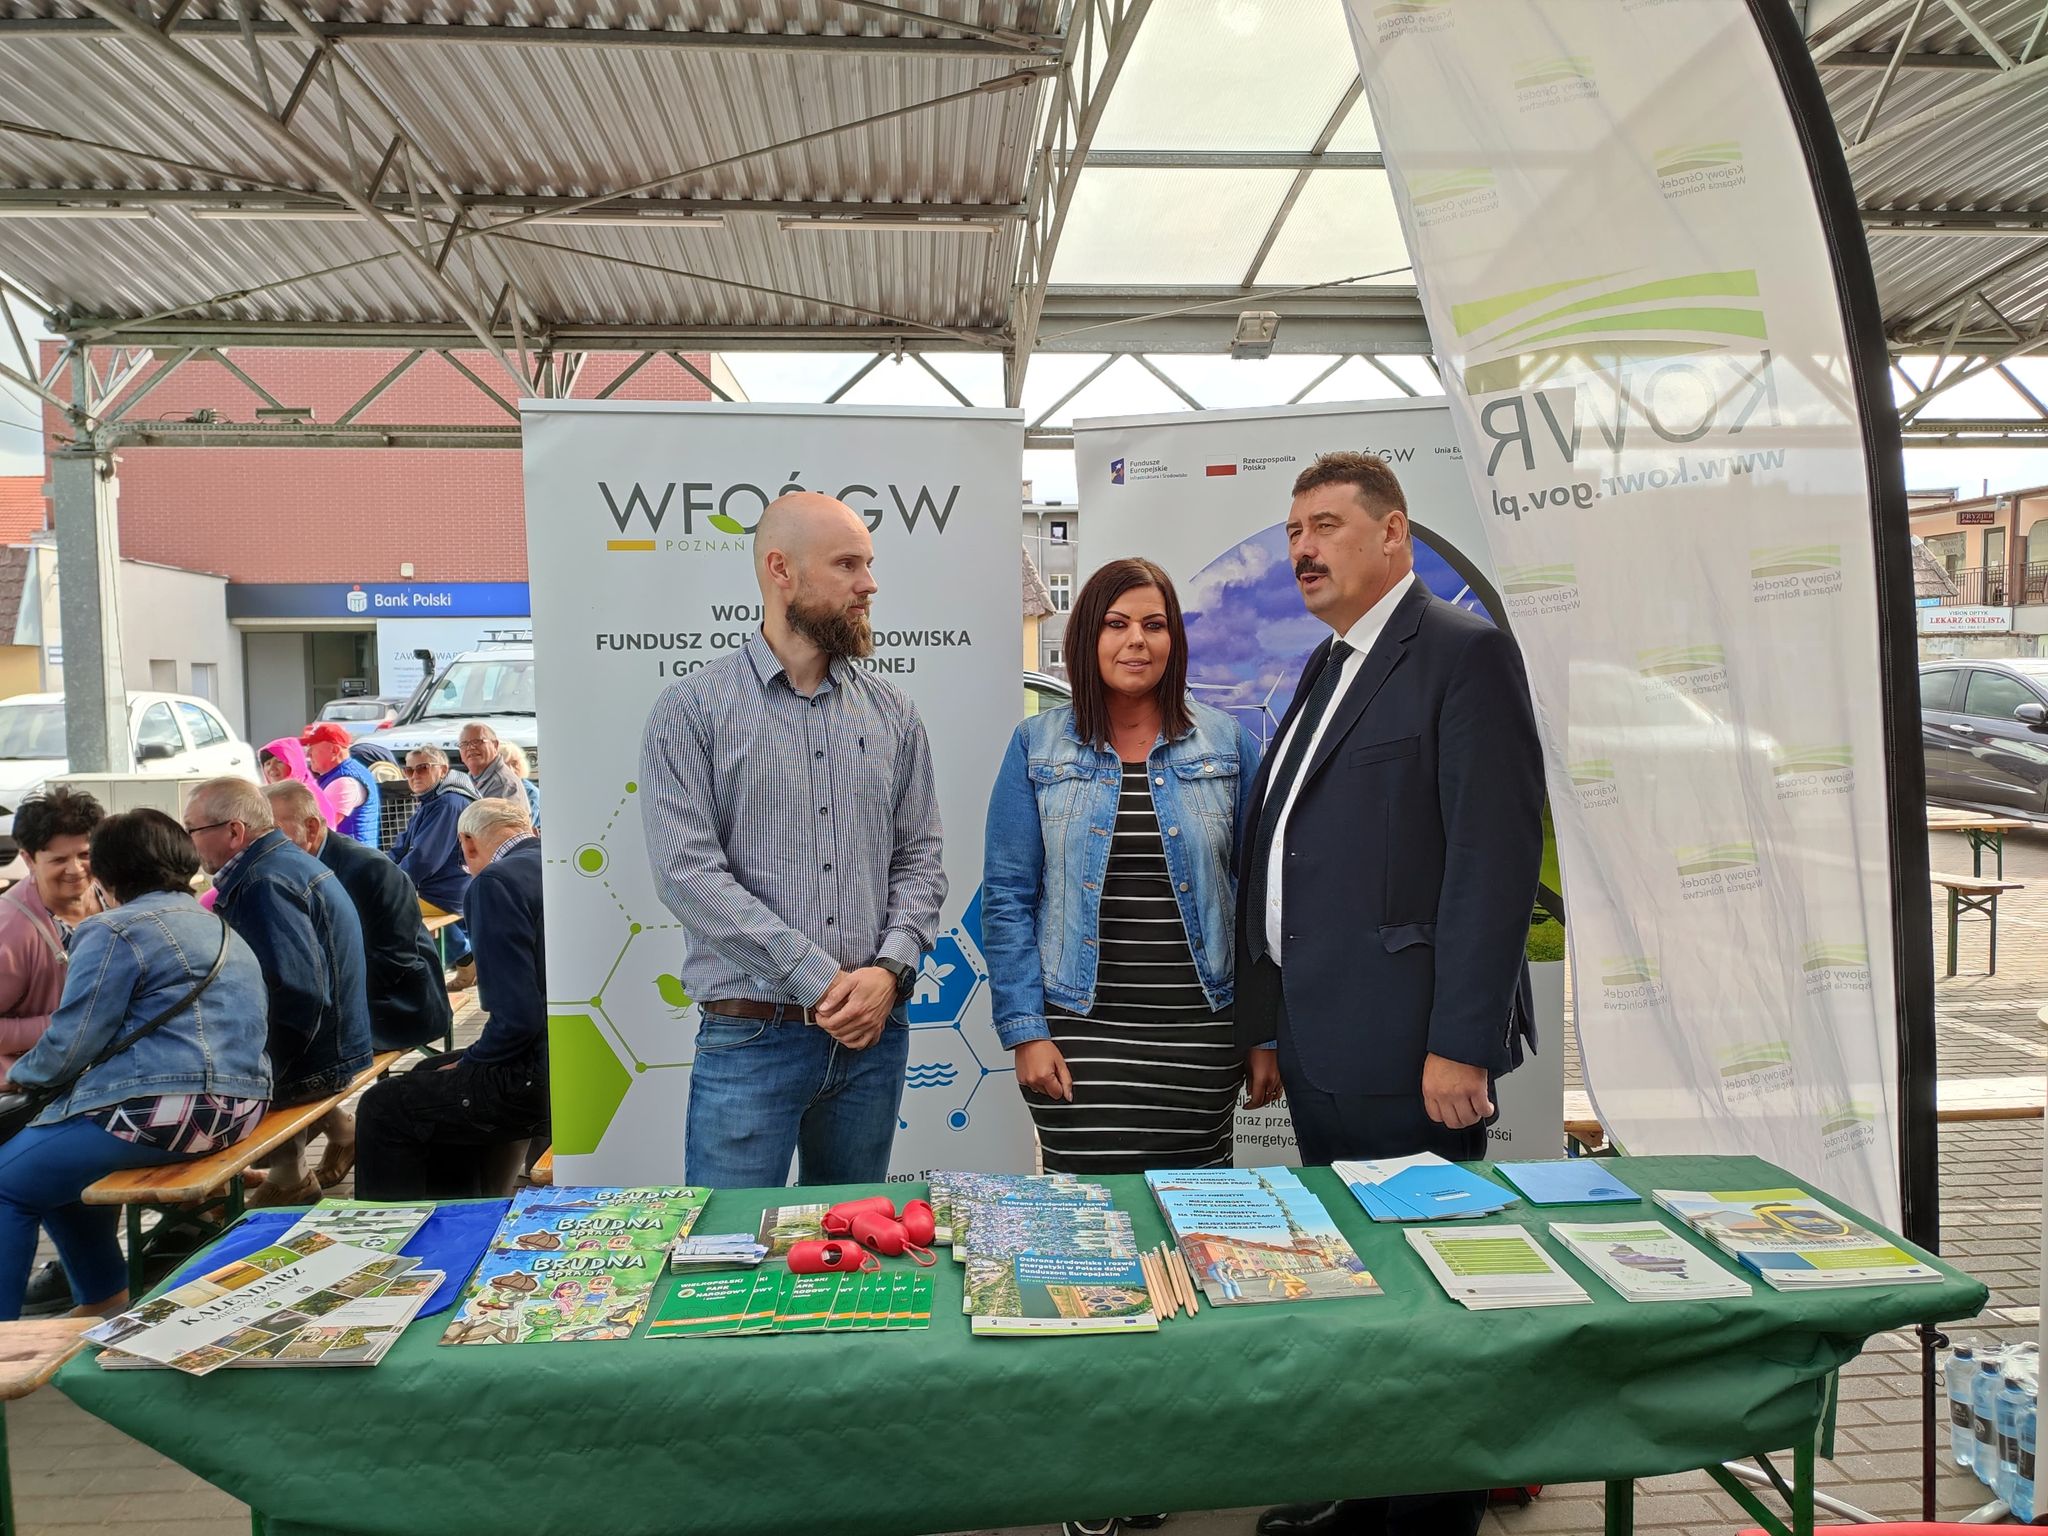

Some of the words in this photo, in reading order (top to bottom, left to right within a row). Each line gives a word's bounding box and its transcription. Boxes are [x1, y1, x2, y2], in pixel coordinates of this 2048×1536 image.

[1130, 459, 1160, 468] Fundusze
[1243, 455, 1296, 464] Rzeczpospolita
[1130, 465, 1168, 474] Europejskie
[1961, 512, 1993, 520] FRYZJER
[665, 537, 744, 552] POZNAŃ
[374, 593, 408, 607] Bank
[413, 592, 451, 607] Polski
[1965, 616, 2006, 624] OKULISTA
[596, 632, 702, 650] FUNDUSZ
[873, 630, 971, 647] DOWISKA
[659, 661, 664, 677] I
[1236, 1116, 1261, 1126] oraz
[1265, 1117, 1291, 1129] prze
[1487, 1127, 1512, 1141] ości
[595, 1188, 695, 1201] BRUDNA
[556, 1217, 662, 1231] BRUDNA
[1750, 1236, 1873, 1247] Termomodernizacja
[533, 1254, 646, 1272] BRUDNA
[1019, 1256, 1054, 1264] Ochrona
[1055, 1258, 1103, 1266] środowiska
[1020, 1262, 1066, 1271] energetyki
[680, 1278, 744, 1288] WIELKOPOLSKI
[706, 1284, 730, 1292] PARK
[180, 1267, 306, 1326] KALENDARZ
[695, 1288, 747, 1299] NARODOWY
